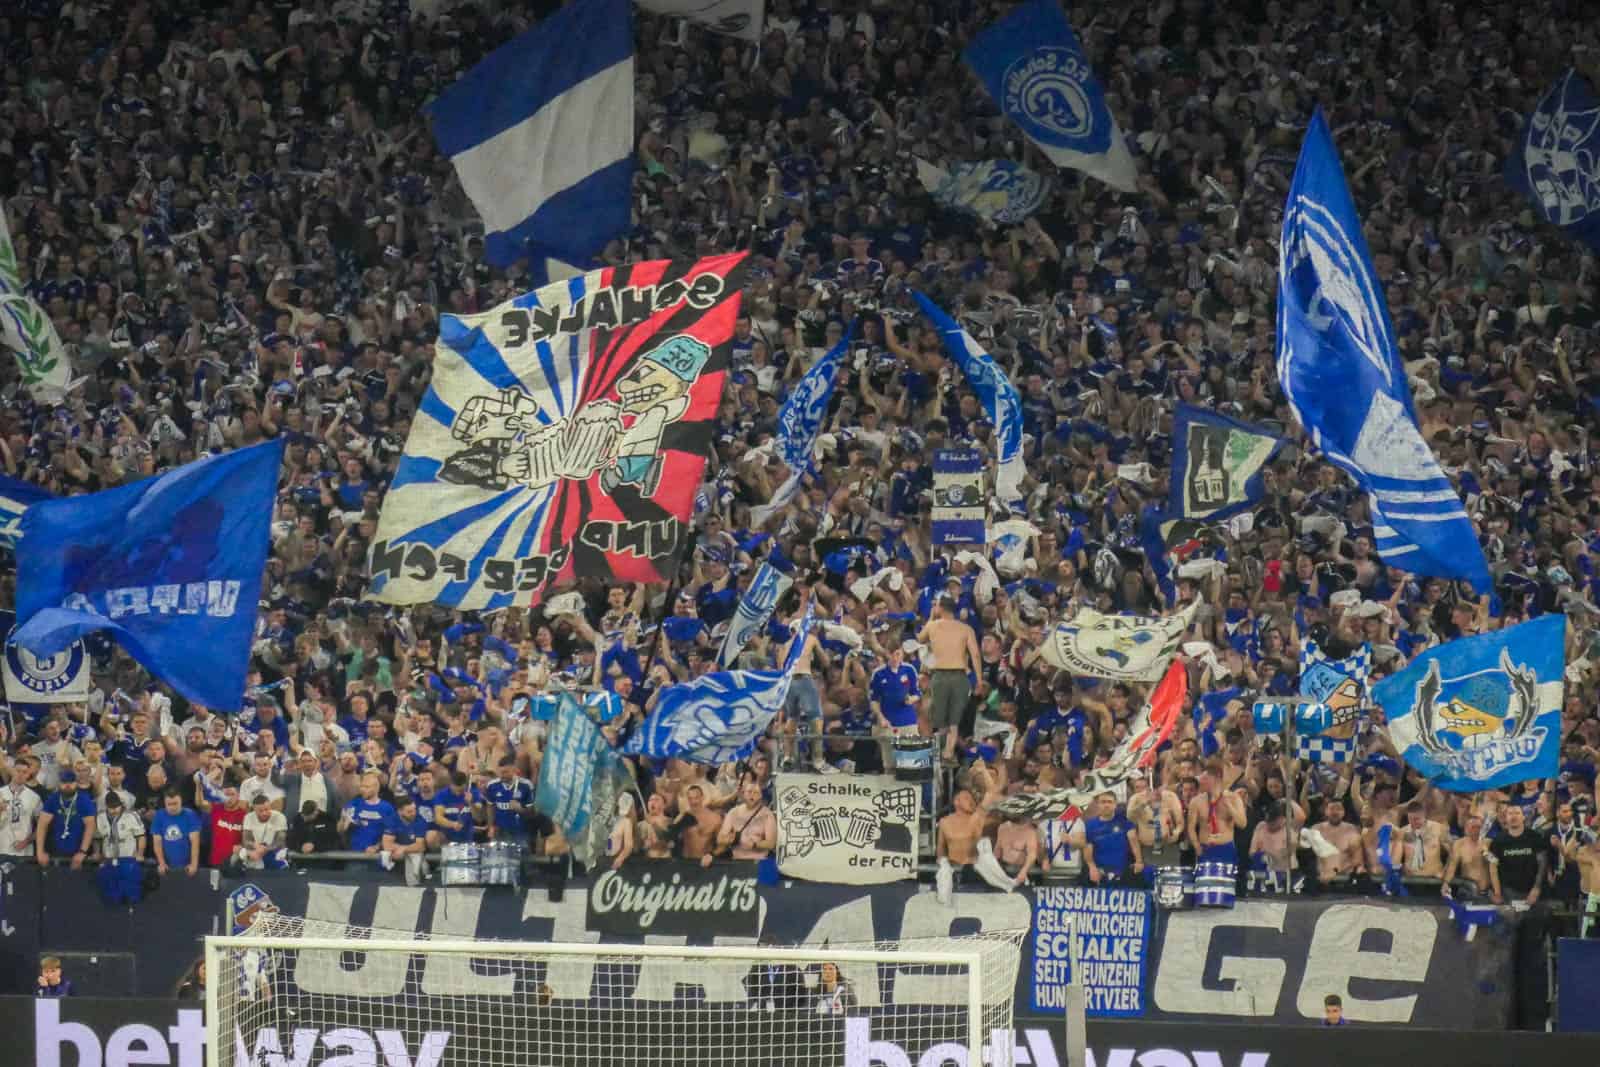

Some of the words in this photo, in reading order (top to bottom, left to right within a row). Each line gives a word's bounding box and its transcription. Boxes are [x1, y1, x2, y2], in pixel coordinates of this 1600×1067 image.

[808, 782, 872, 797] Schalke
[838, 806, 850, 818] &
[848, 854, 876, 867] der
[881, 856, 913, 868] FCN
[591, 868, 728, 928] Original
[730, 878, 758, 912] 75
[1036, 887, 1146, 913] FUSSBALLCLUB
[1037, 908, 1144, 937] GELSNKIRCHEN
[1035, 959, 1068, 983] SEIT
[1079, 961, 1140, 986] EUNZEHN
[1035, 985, 1140, 1010] HUNRTVIER
